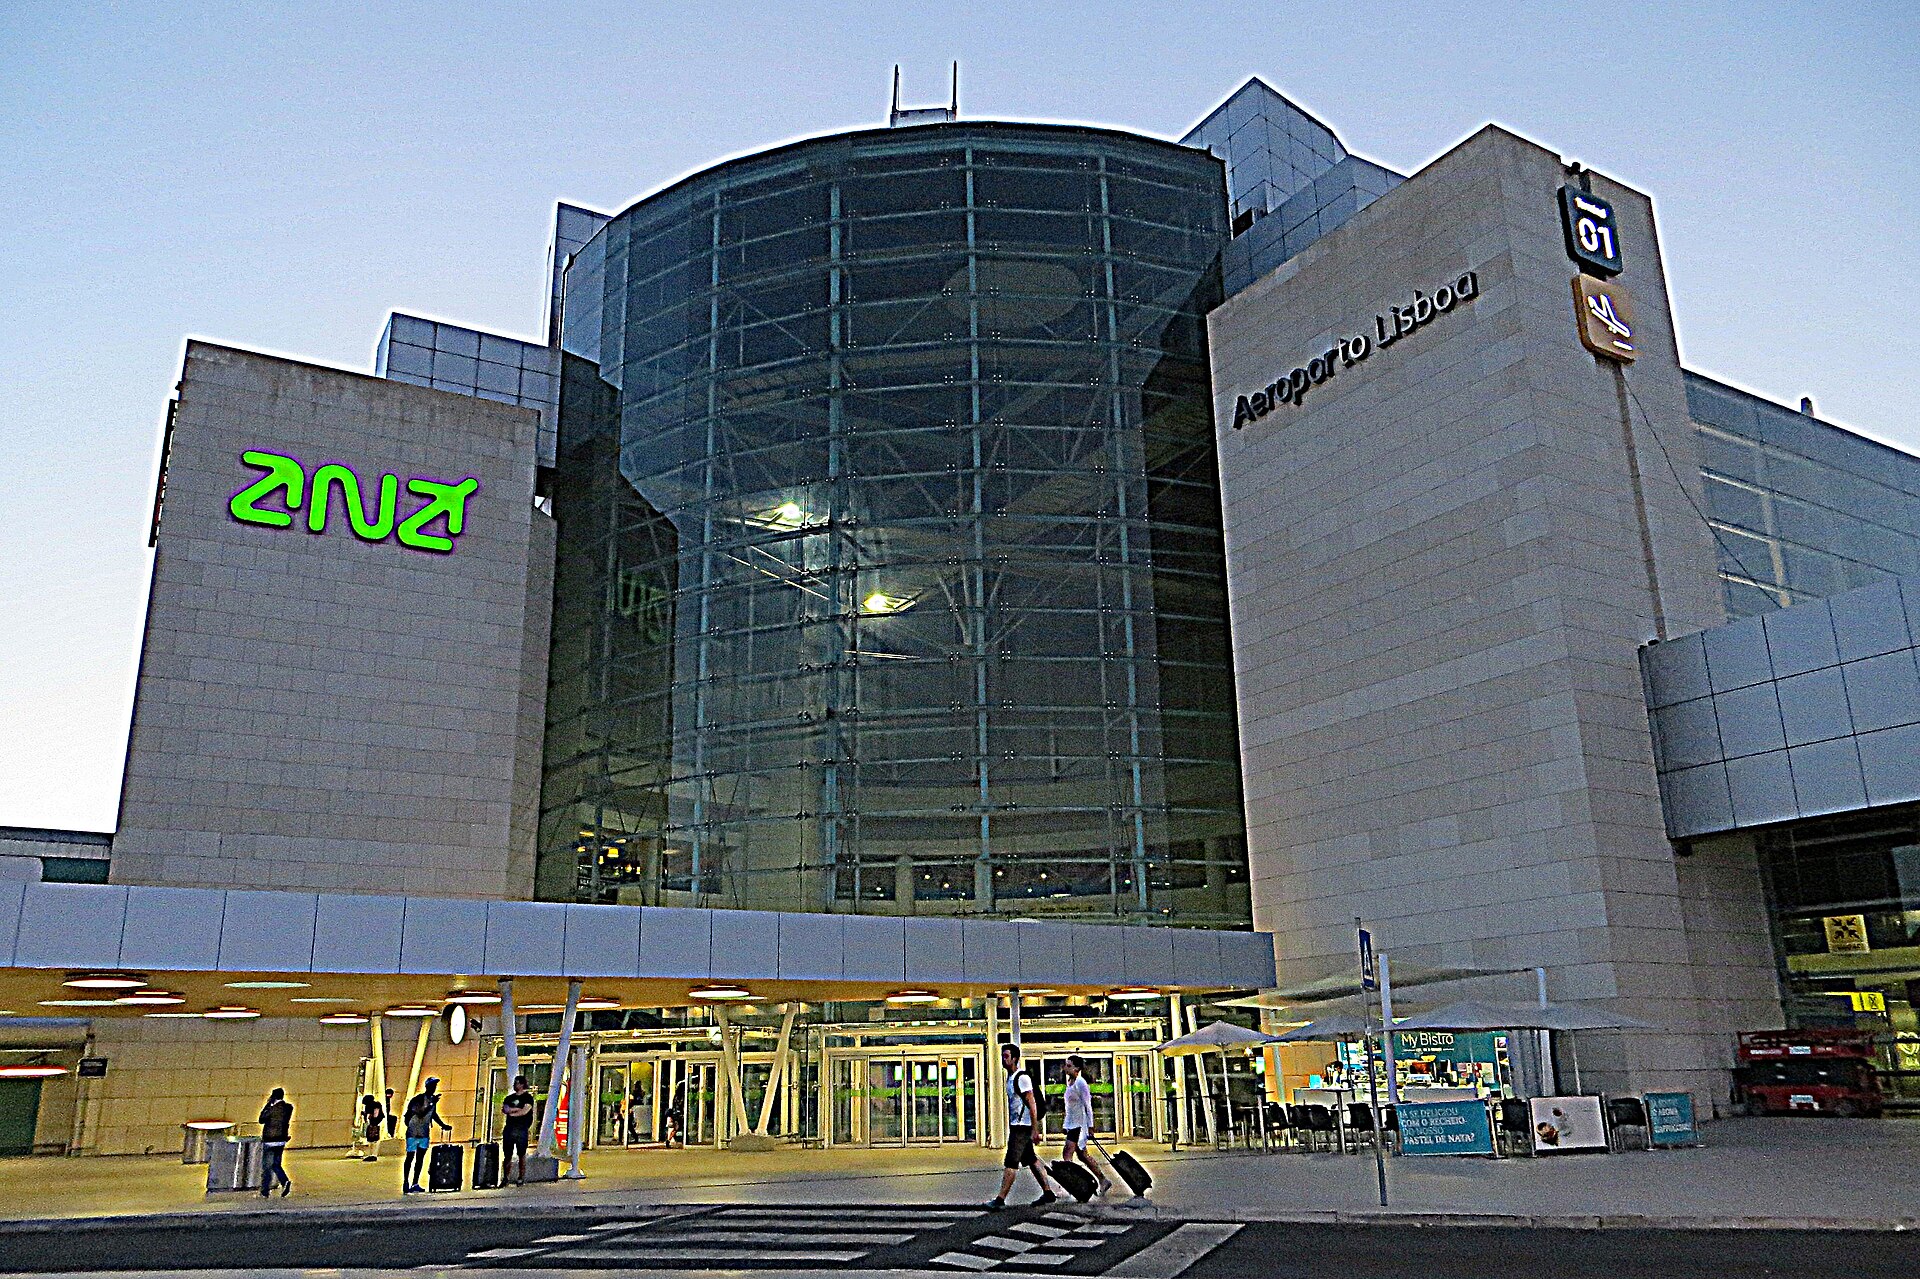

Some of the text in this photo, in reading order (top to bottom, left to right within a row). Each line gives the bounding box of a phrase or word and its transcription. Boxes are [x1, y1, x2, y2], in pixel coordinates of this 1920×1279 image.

[1232, 271, 1480, 430] Aeroporto Lisboa
[1401, 1032, 1454, 1048] My Bistro
[1404, 1135, 1434, 1145] PASTEL
[1435, 1134, 1447, 1143] DE
